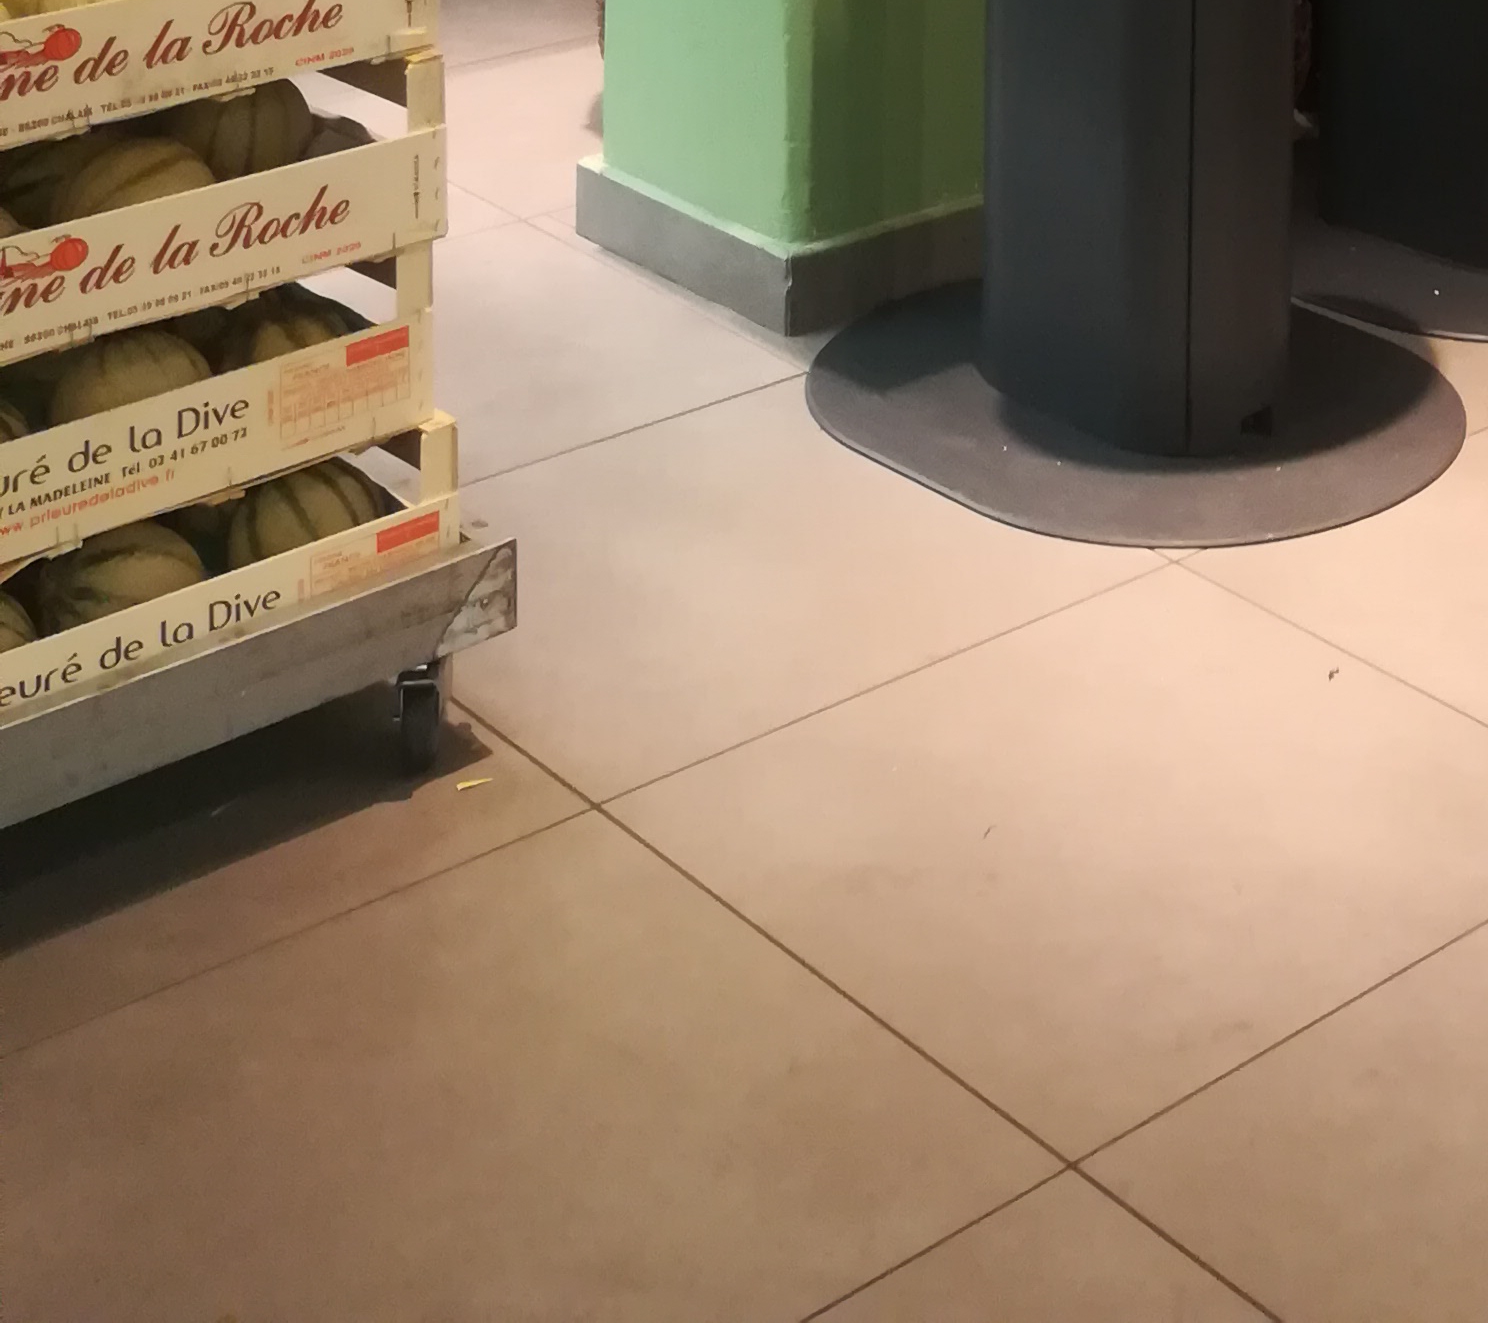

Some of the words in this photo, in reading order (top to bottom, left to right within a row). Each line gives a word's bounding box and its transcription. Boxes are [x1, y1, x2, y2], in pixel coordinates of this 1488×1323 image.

[73, 36, 129, 85] de
[143, 18, 192, 69] la
[0, 275, 66, 317] ne
[79, 243, 136, 294] de
[152, 224, 200, 275] la
[209, 183, 350, 257] Roche
[7, 499, 25, 516] LA
[29, 472, 111, 510] MADELEINE
[169, 448, 185, 462] 41
[190, 440, 208, 456] 67
[211, 432, 229, 448] 00
[67, 439, 113, 474] de
[129, 425, 163, 453] la
[176, 398, 250, 439] Dive
[99, 636, 144, 670] de
[160, 620, 195, 647] la
[208, 590, 281, 632] Dive
